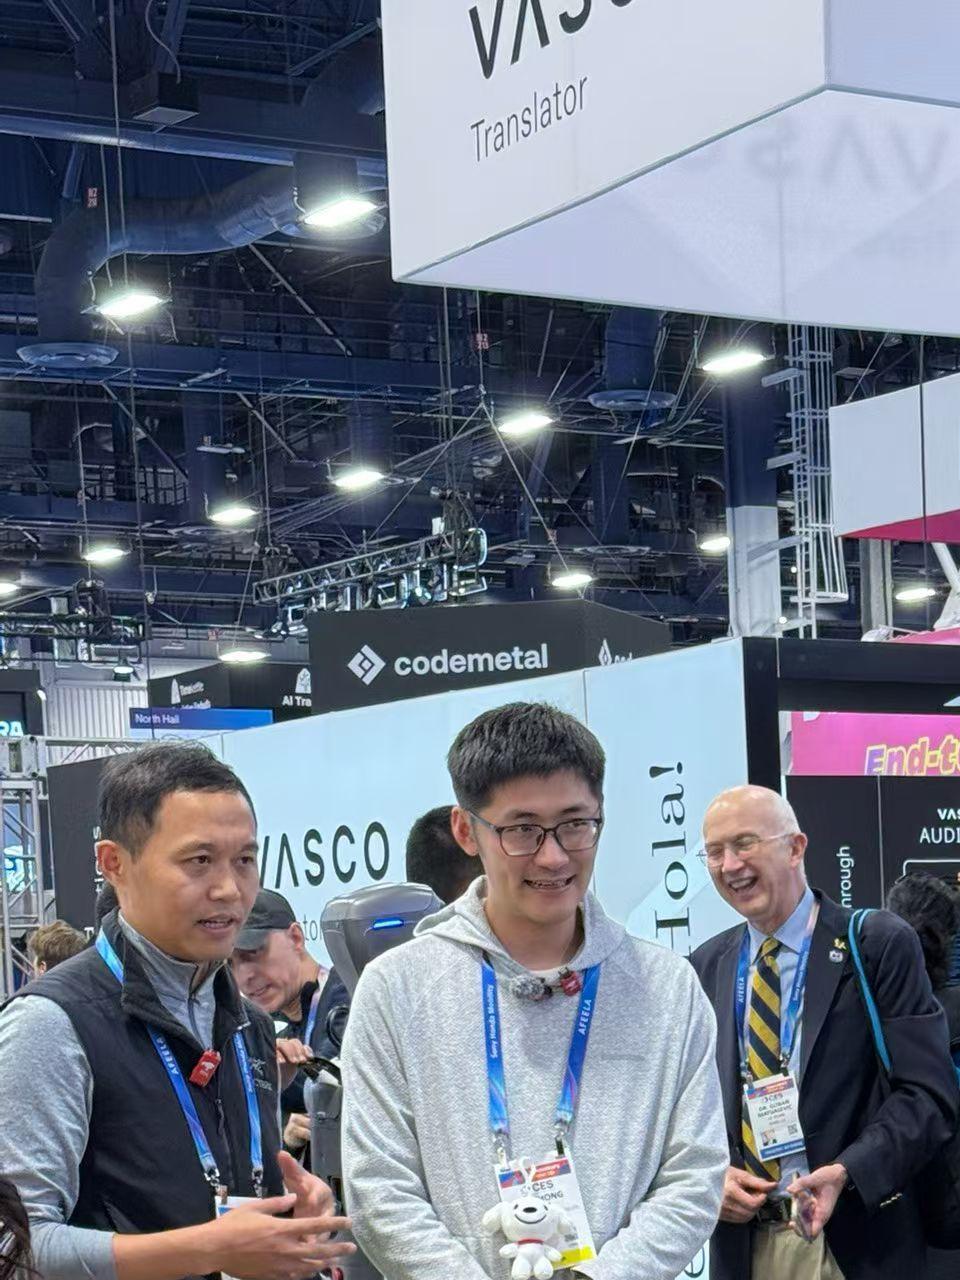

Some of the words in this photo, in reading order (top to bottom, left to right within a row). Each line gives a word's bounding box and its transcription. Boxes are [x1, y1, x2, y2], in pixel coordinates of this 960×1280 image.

[468, 0, 632, 79] VAS
[470, 76, 588, 162] Translator
[393, 643, 549, 676] codemetal
[135, 713, 160, 725] North
[162, 713, 180, 725] Hall
[648, 761, 692, 960] Hola!
[577, 999, 592, 1036] AFEELA
[532, 1180, 554, 1192] CES
